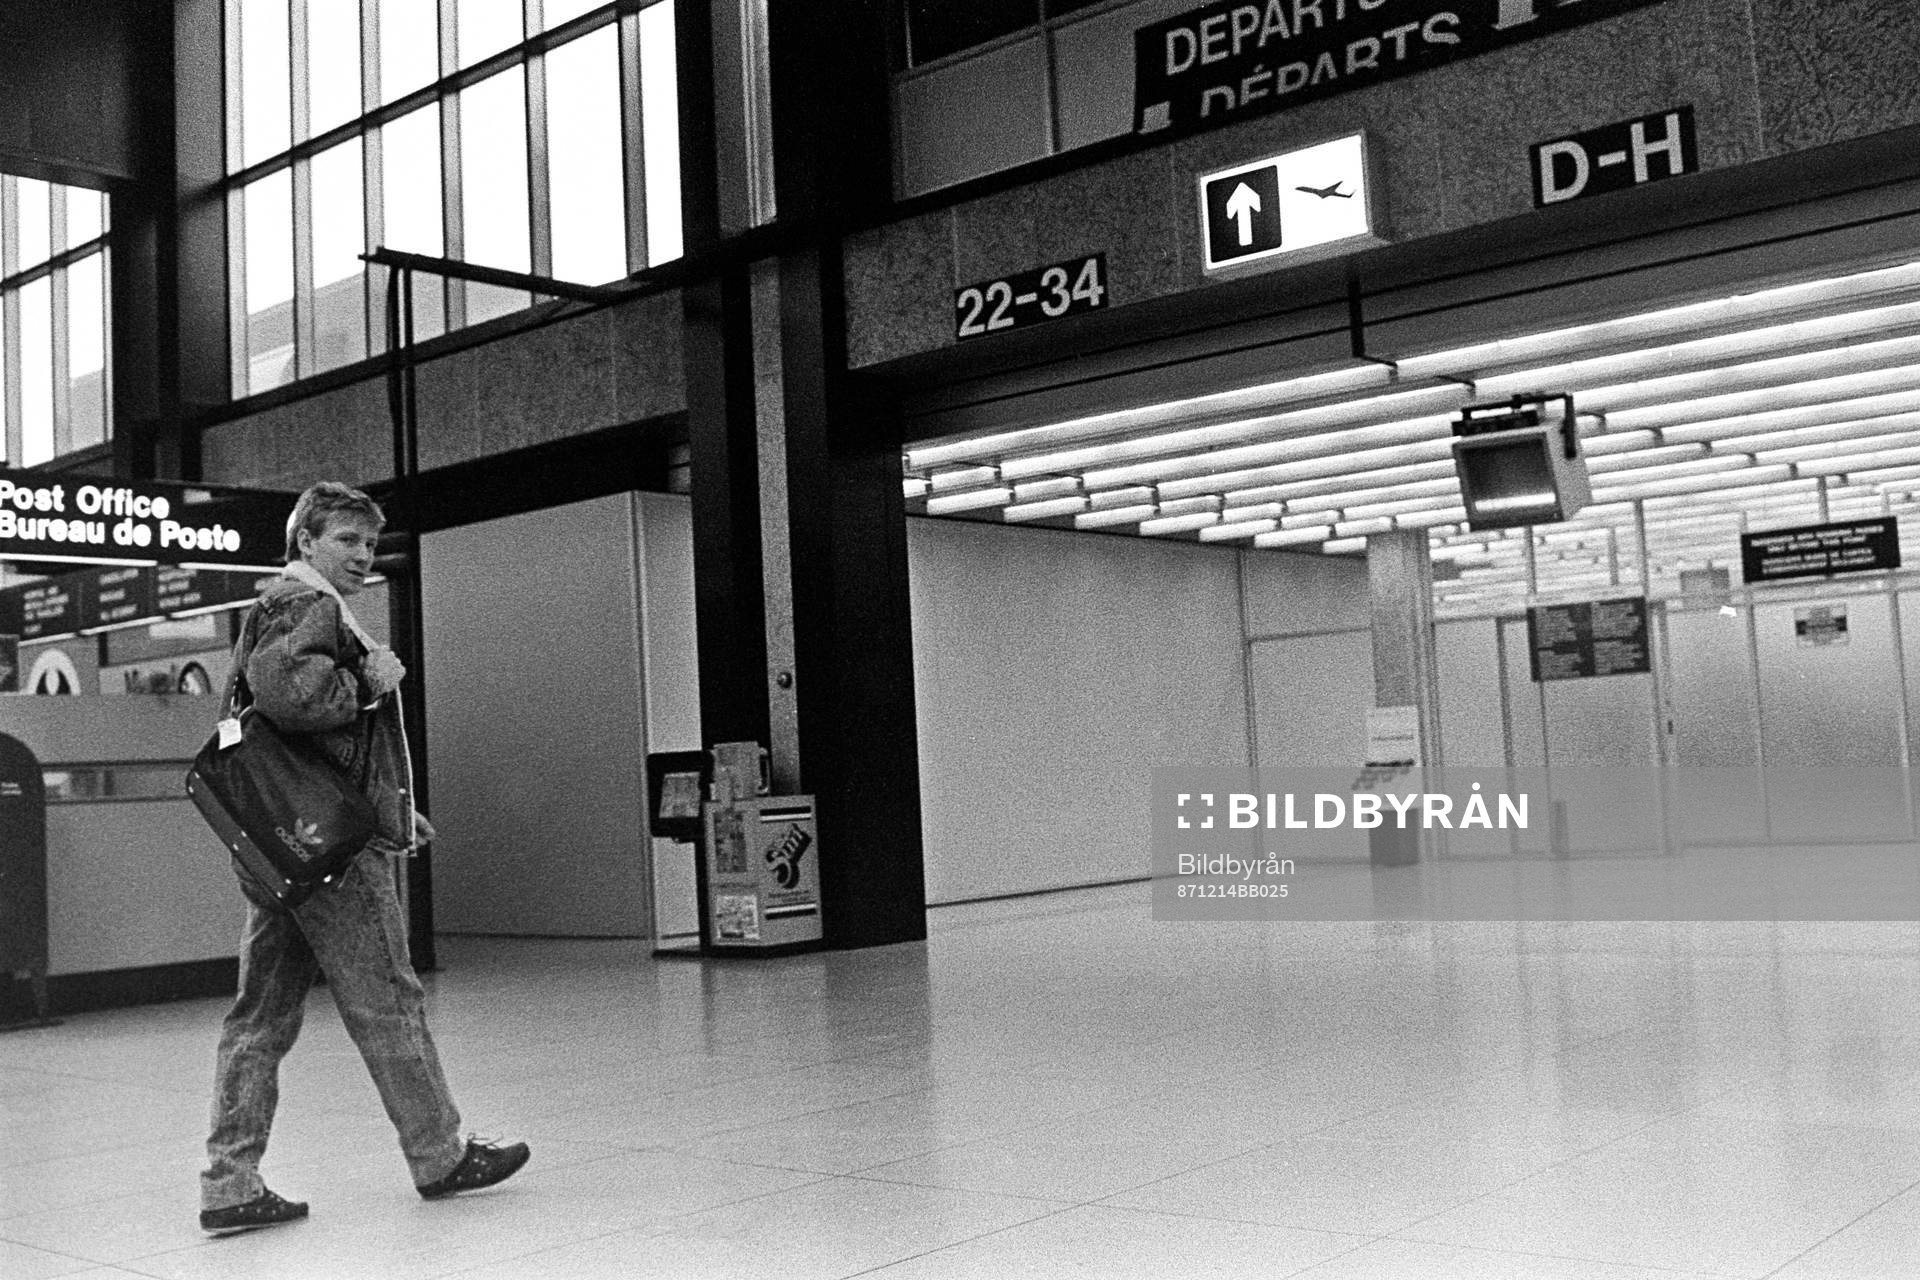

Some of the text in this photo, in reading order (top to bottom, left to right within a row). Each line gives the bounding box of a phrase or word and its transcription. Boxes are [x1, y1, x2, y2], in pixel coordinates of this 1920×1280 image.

[1165, 0, 1387, 76] DEPAR
[1538, 112, 1684, 205] D-H
[957, 258, 1104, 337] 22-34
[0, 480, 170, 519] Post Office
[0, 510, 241, 552] Bureau de Poste
